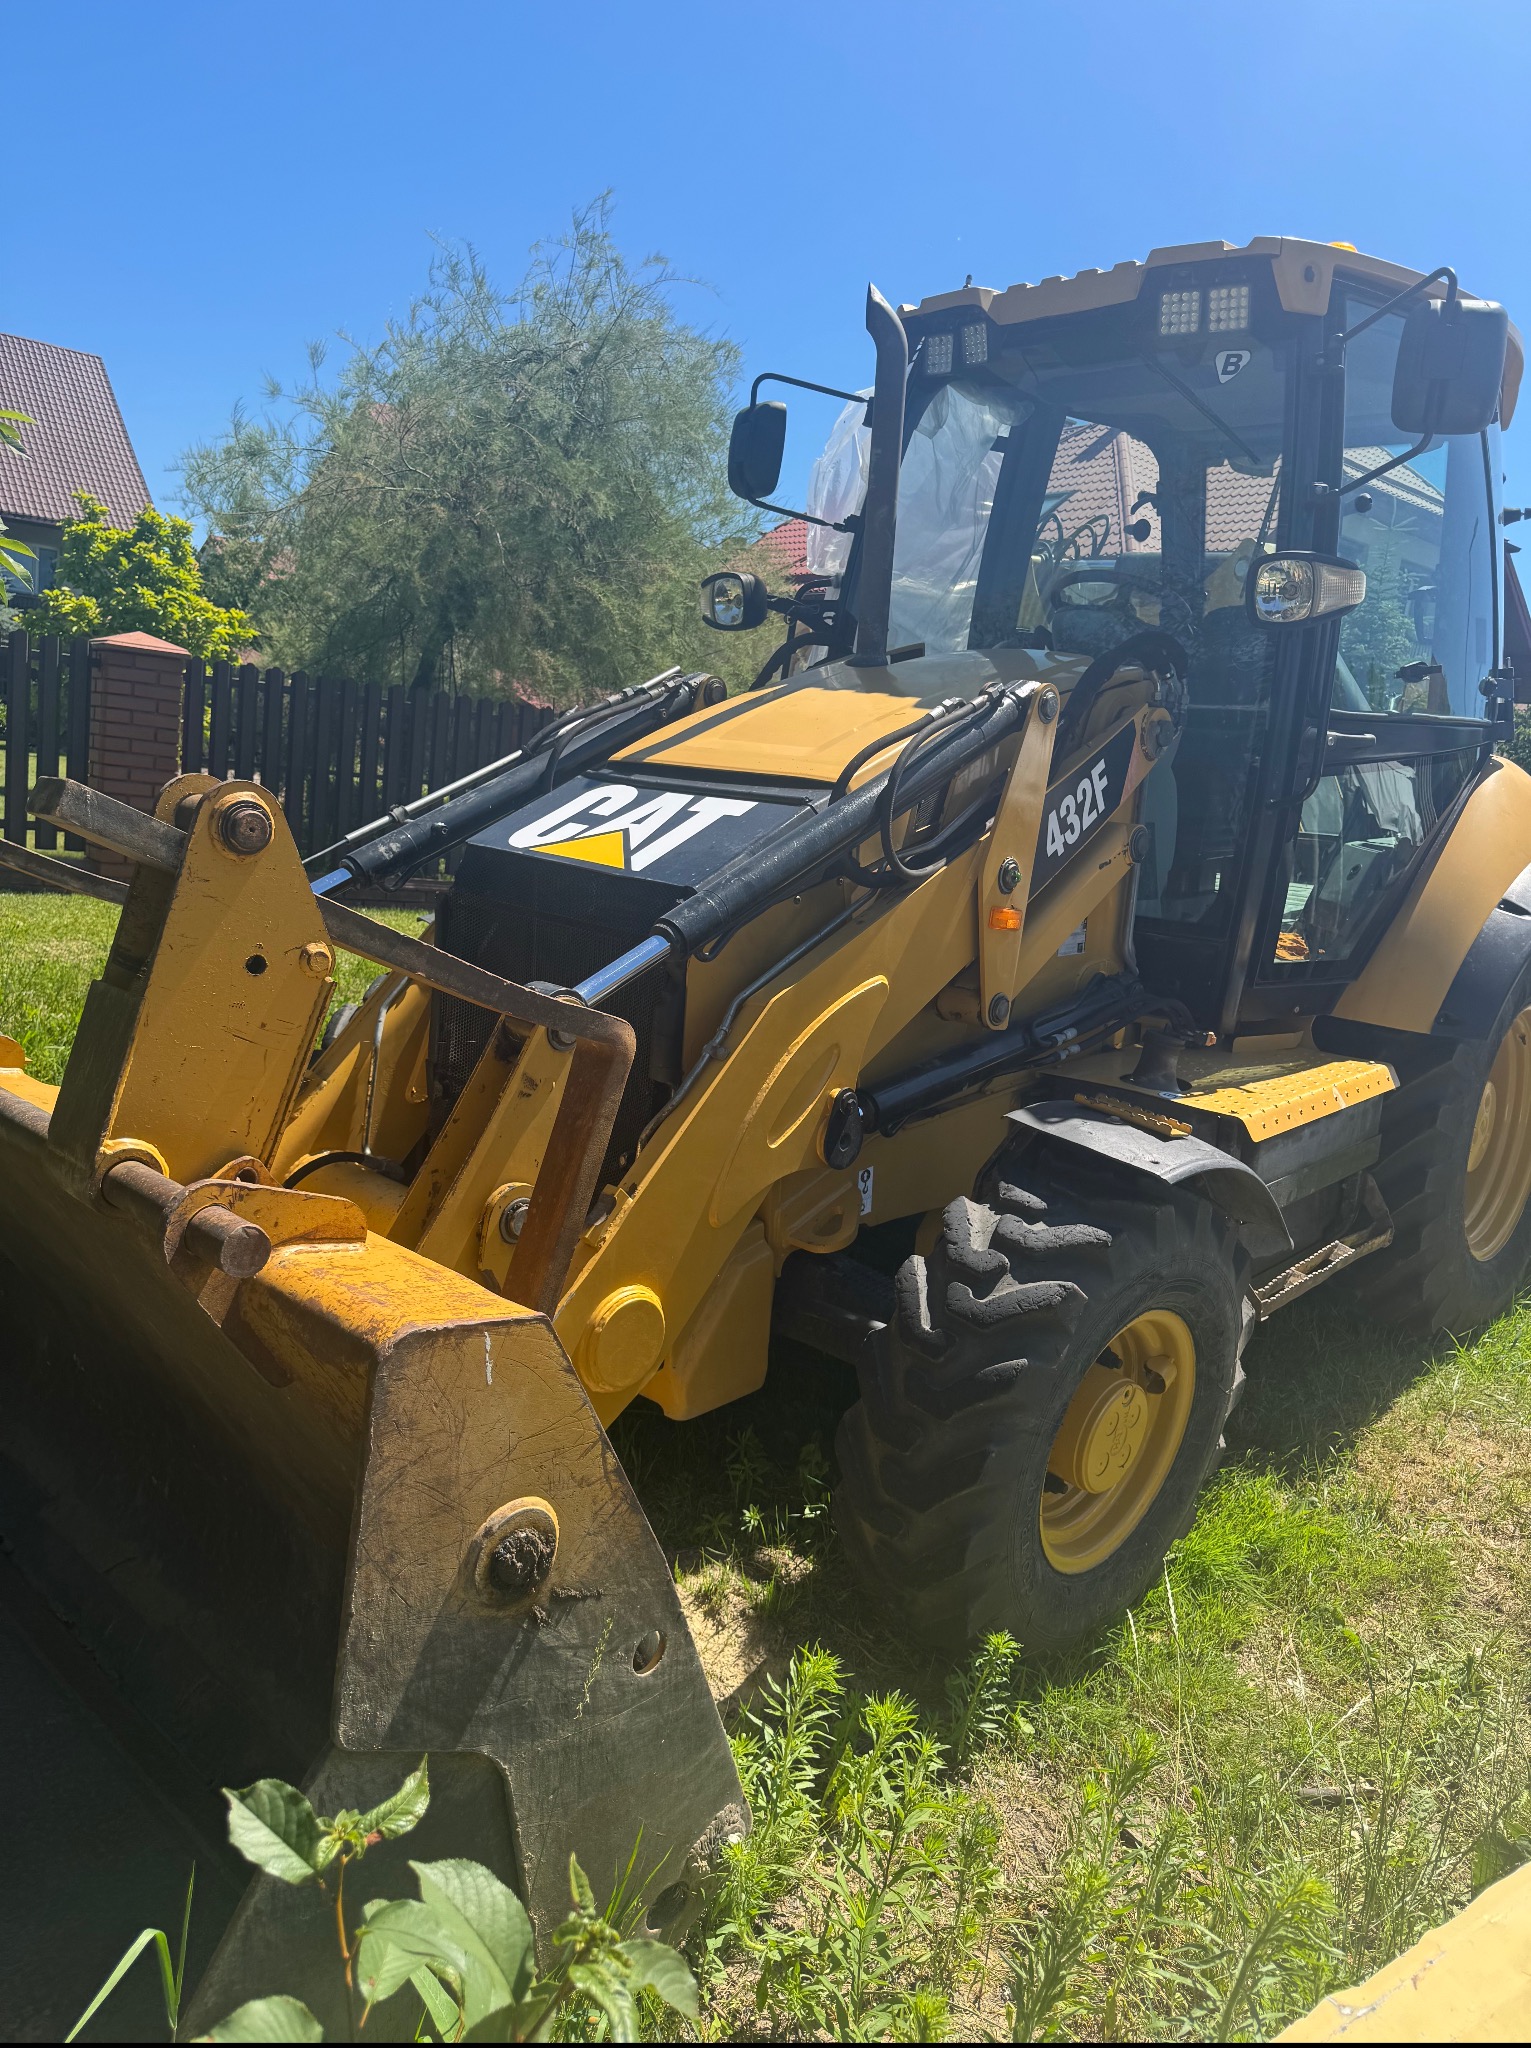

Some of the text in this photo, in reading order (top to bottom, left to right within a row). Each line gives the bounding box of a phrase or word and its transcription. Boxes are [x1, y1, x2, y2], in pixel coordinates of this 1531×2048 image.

[1221, 353, 1243, 376] B
[508, 784, 759, 872] CAT
[1046, 758, 1109, 857] 432F
